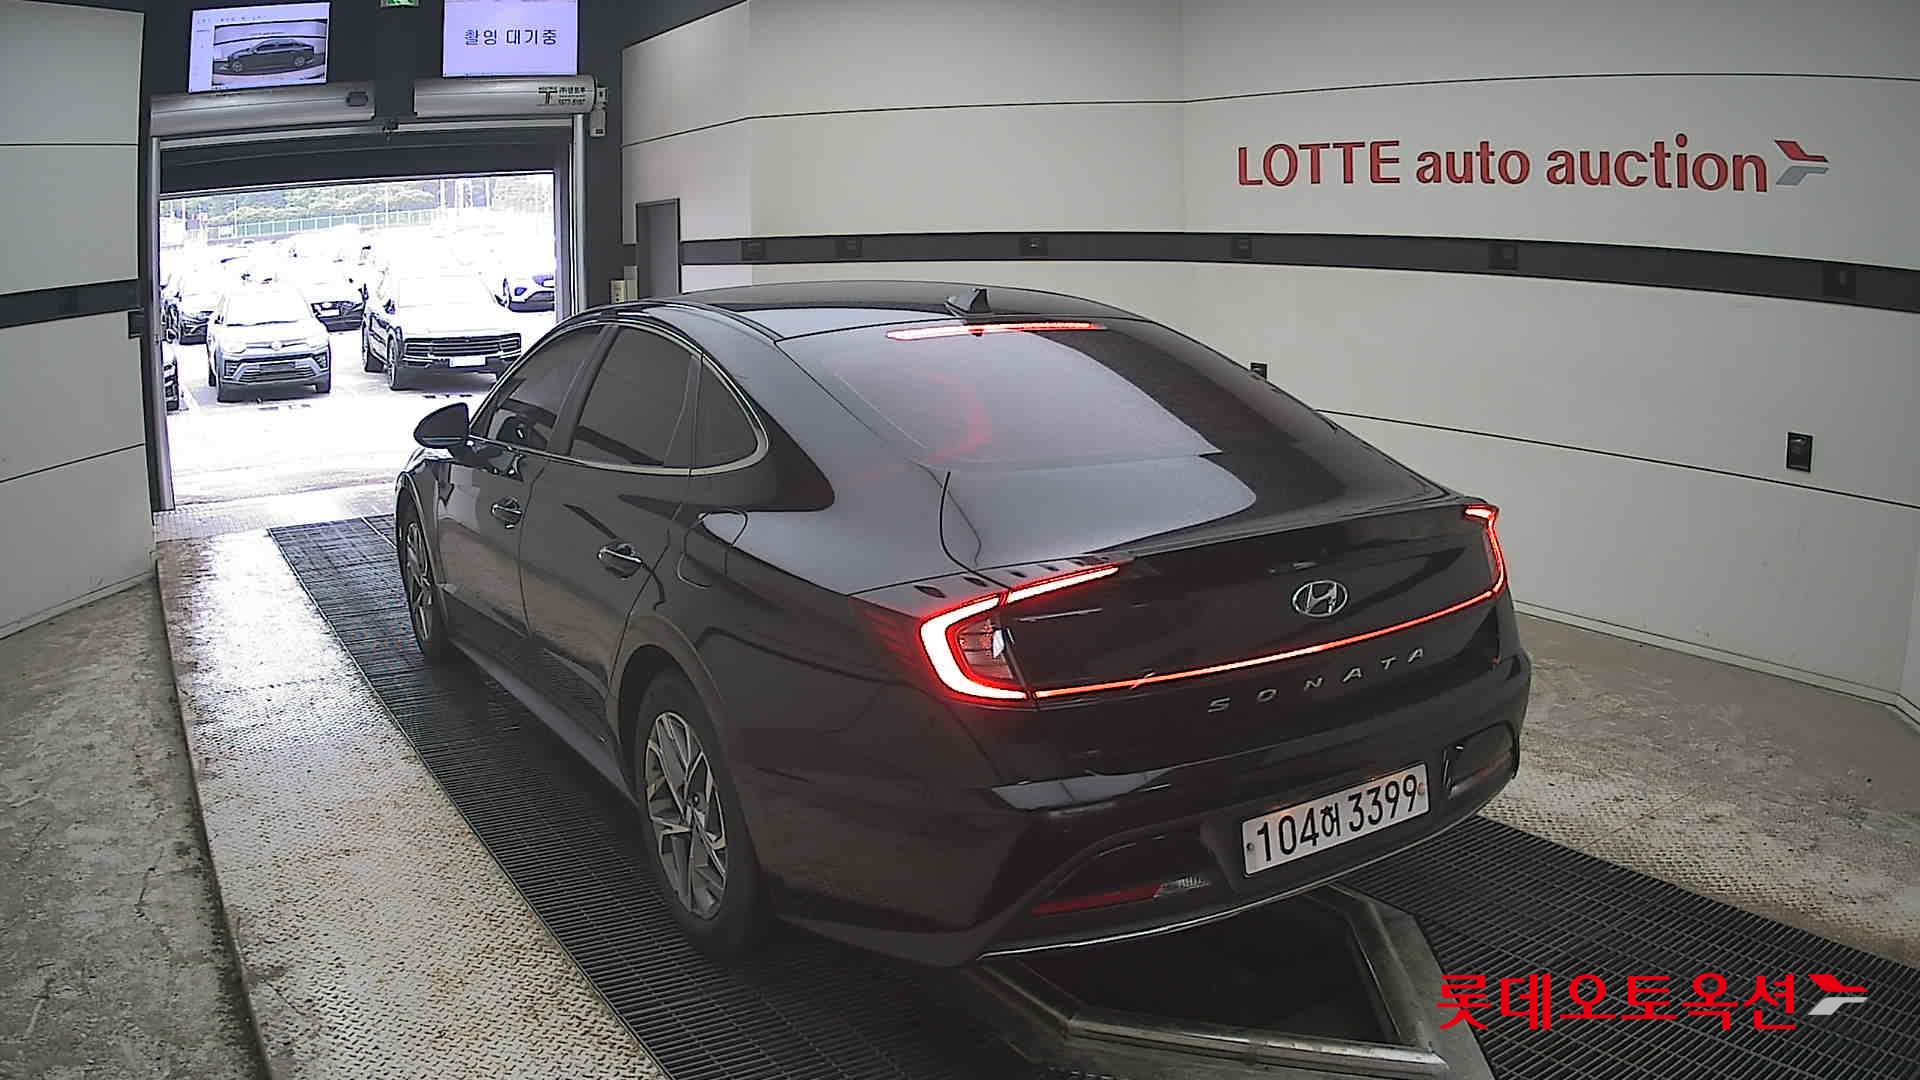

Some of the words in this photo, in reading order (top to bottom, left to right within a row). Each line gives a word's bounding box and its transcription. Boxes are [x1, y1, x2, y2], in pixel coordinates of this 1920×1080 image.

[506, 29, 557, 46] 대기중
[1238, 140, 1400, 187] LOTTE
[1415, 140, 1531, 185] auto
[1545, 133, 1768, 193] auction
[1207, 648, 1424, 713] SONATA
